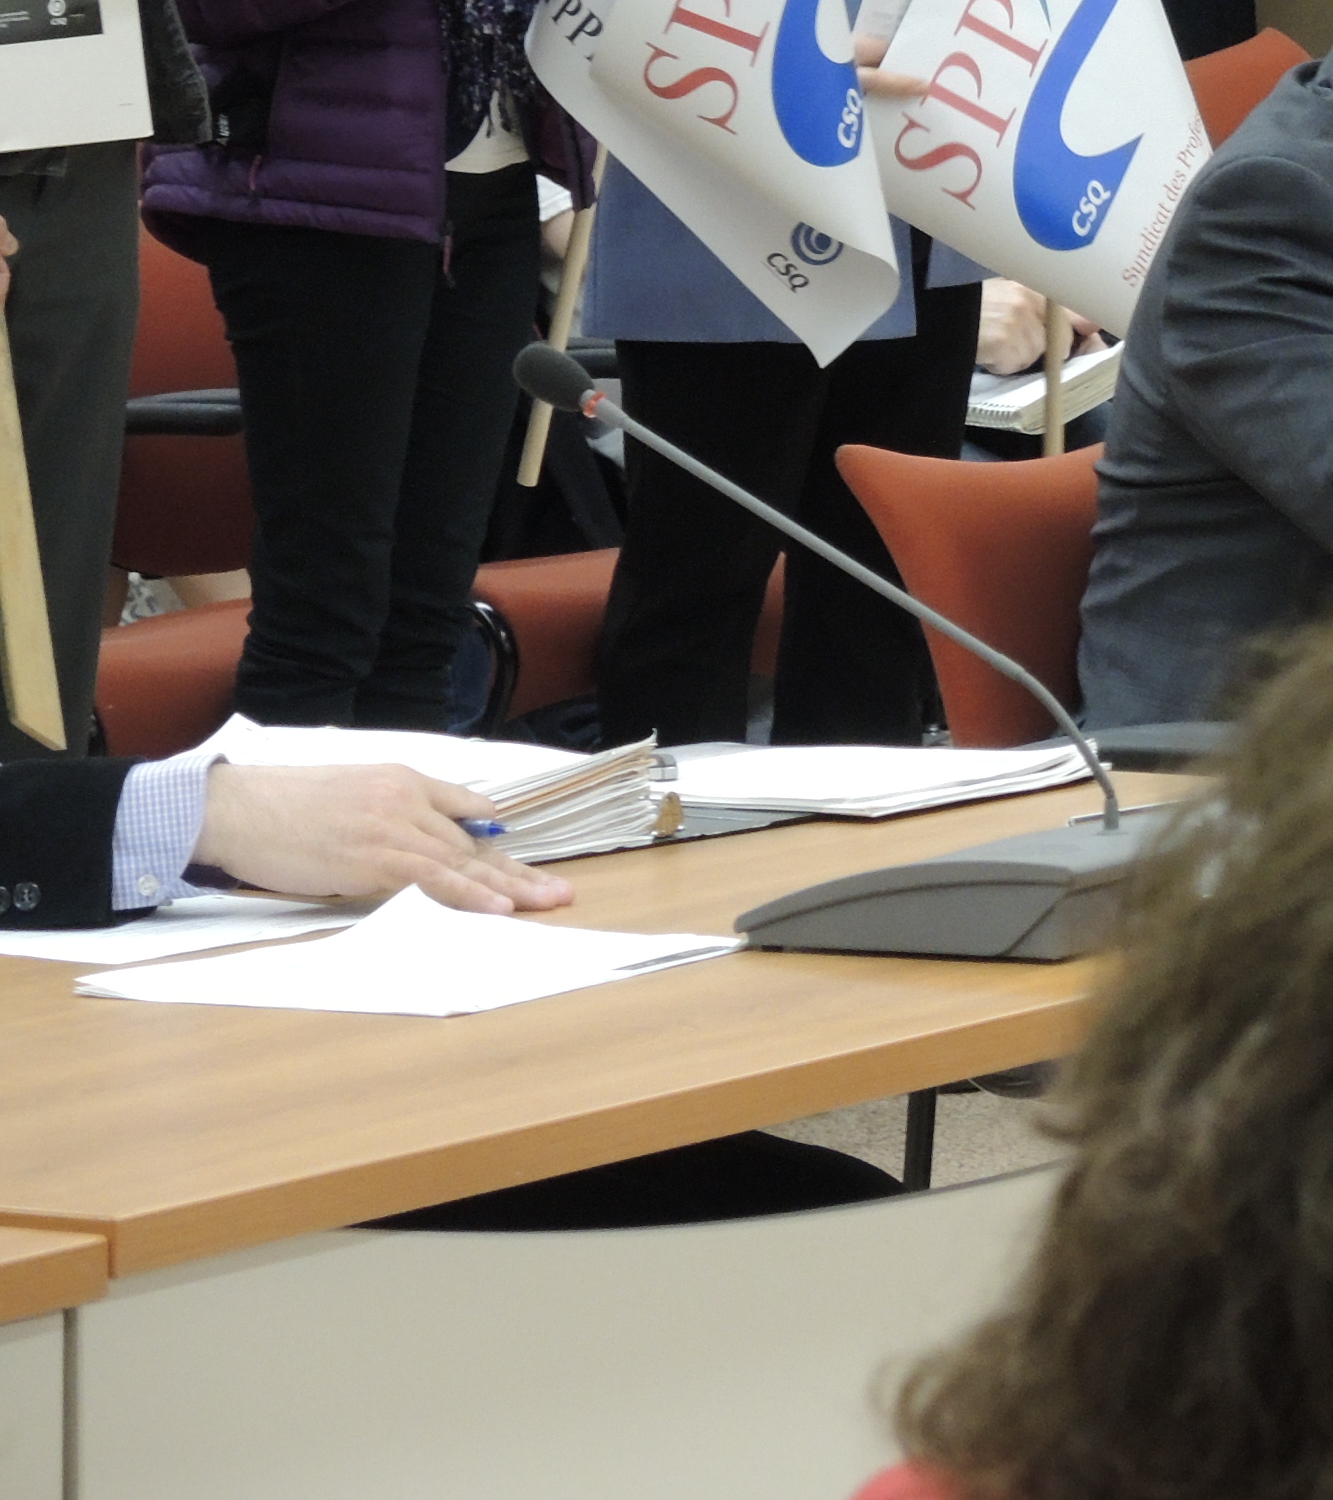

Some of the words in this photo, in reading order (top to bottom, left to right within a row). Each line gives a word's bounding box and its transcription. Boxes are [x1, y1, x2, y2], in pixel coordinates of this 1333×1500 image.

[1072, 180, 1111, 237] CSQ
[1121, 203, 1173, 288] Syndicat
[1163, 169, 1187, 203] des
[766, 252, 810, 293] CSQ
